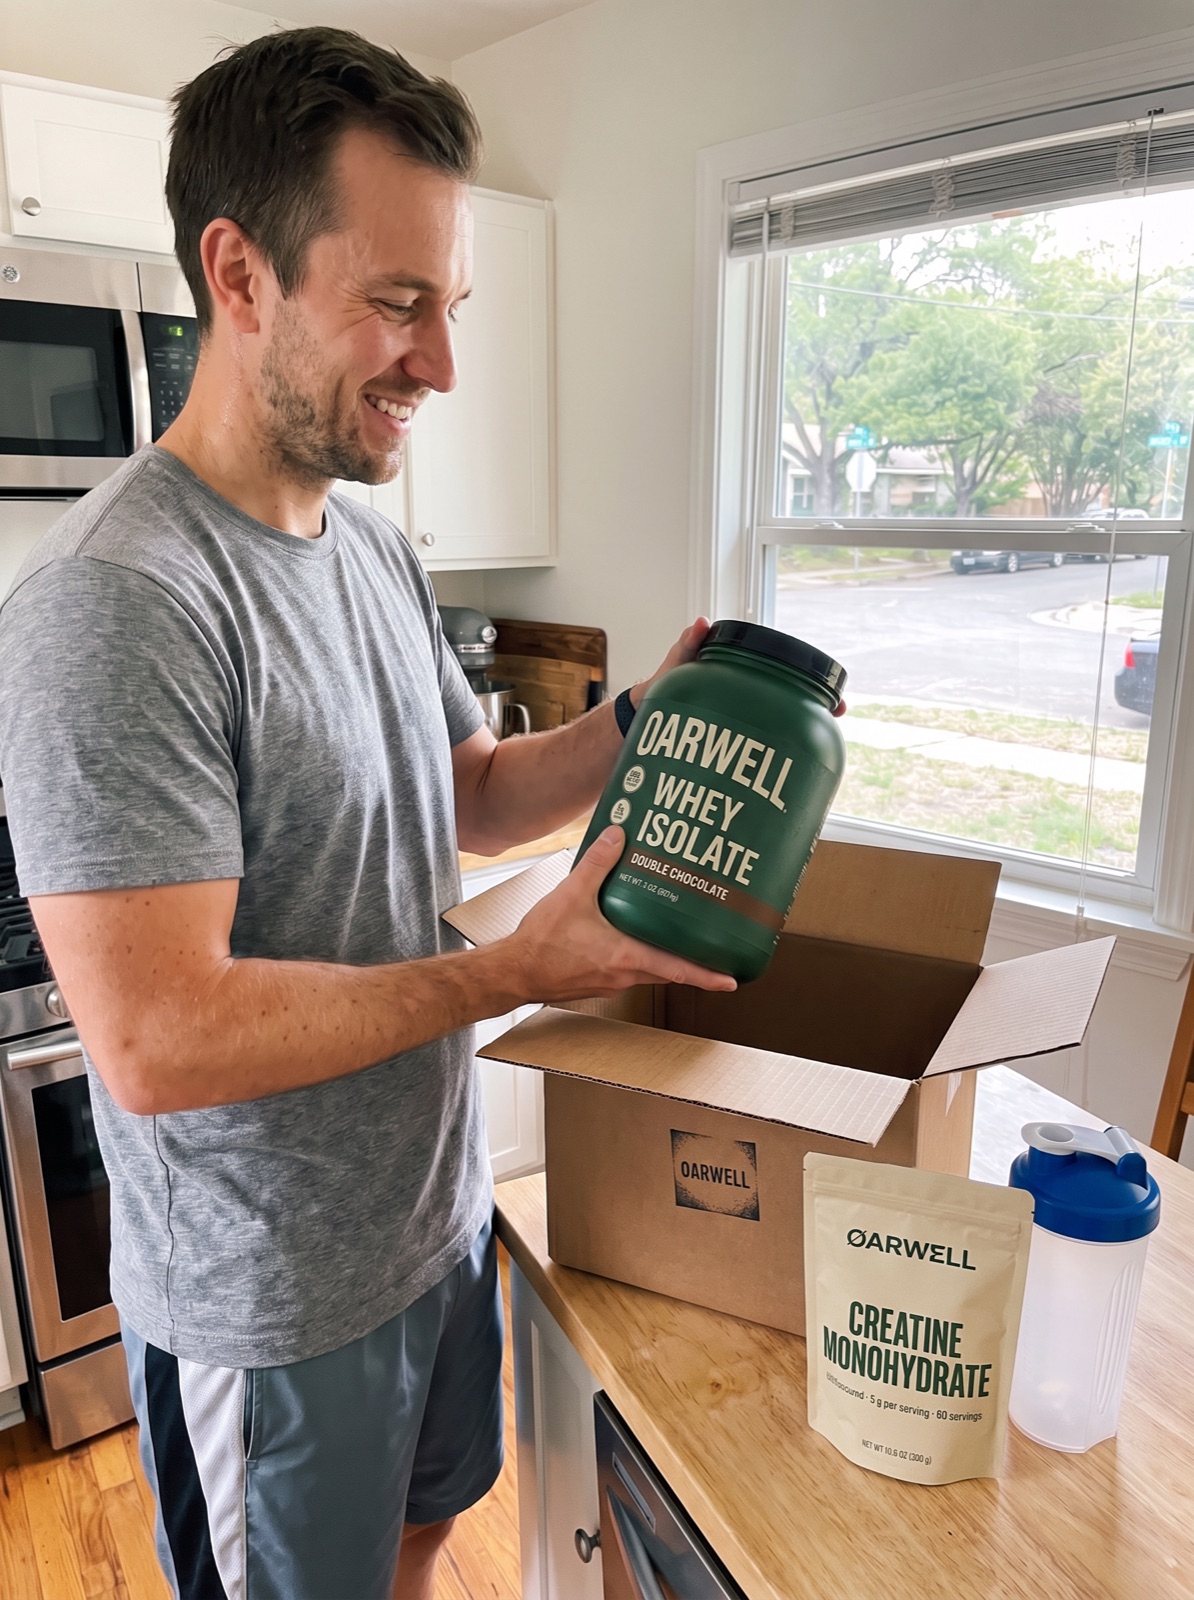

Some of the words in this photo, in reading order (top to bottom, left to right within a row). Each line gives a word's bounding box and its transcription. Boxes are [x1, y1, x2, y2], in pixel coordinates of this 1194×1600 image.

[637, 710, 793, 811] OARWELL
[653, 772, 745, 832] WHEY
[636, 809, 760, 886] ISOLATE
[630, 852, 671, 876] DOUBLE
[669, 867, 729, 901] CHOCOLATE
[681, 1160, 750, 1189] OARWELL
[849, 1301, 964, 1358] CREATINE
[823, 1325, 993, 1398] MONOHYDRATE
[869, 1394, 876, 1404] 5
[876, 1399, 882, 1408] g
[883, 1401, 897, 1411] per
[899, 1404, 930, 1419] serving
[936, 1409, 948, 1420] 60
[948, 1411, 983, 1423] servings
[862, 1439, 873, 1449] NET
[873, 1443, 884, 1453] WT
[898, 1450, 908, 1460] OZ
[908, 1452, 925, 1464] (300
[924, 1456, 932, 1466] g)
